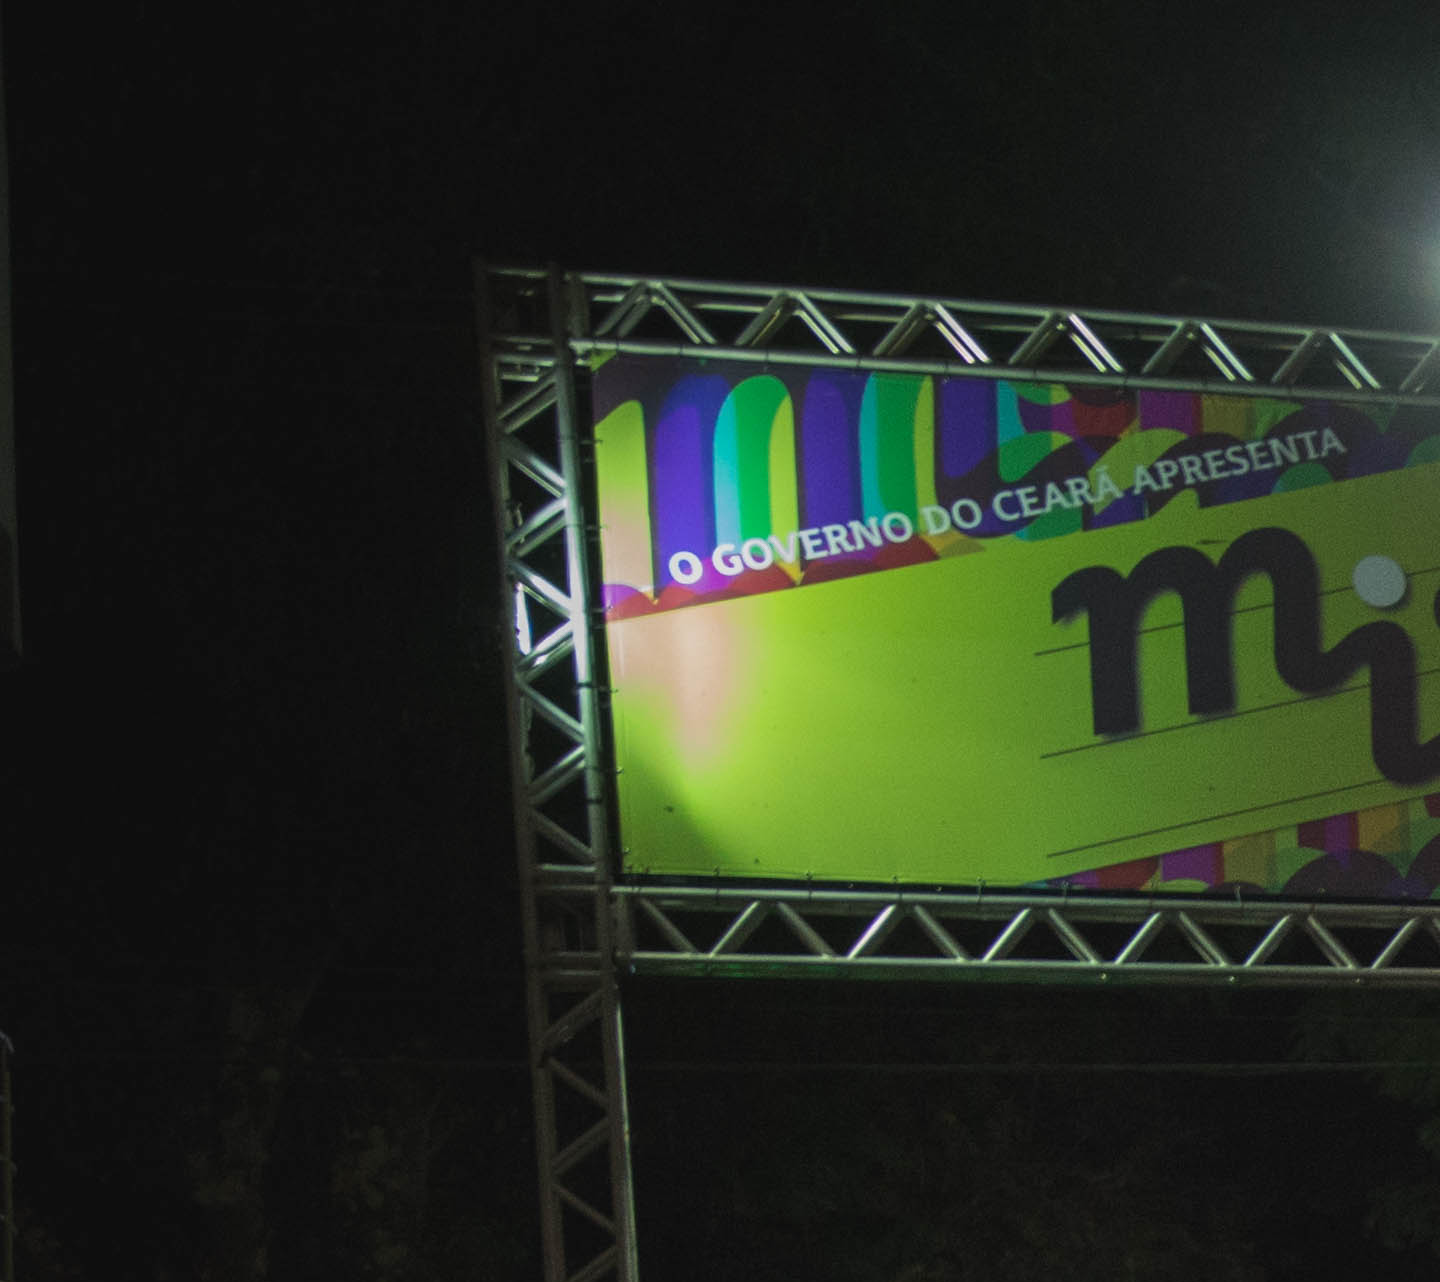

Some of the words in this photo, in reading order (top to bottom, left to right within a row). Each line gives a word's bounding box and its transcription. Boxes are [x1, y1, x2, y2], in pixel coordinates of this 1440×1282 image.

[666, 550, 703, 585] O
[710, 511, 915, 579] GOVERNO
[920, 499, 980, 540] DO
[992, 465, 1123, 526] CEARÁ
[1131, 427, 1348, 497] APRESENTA
